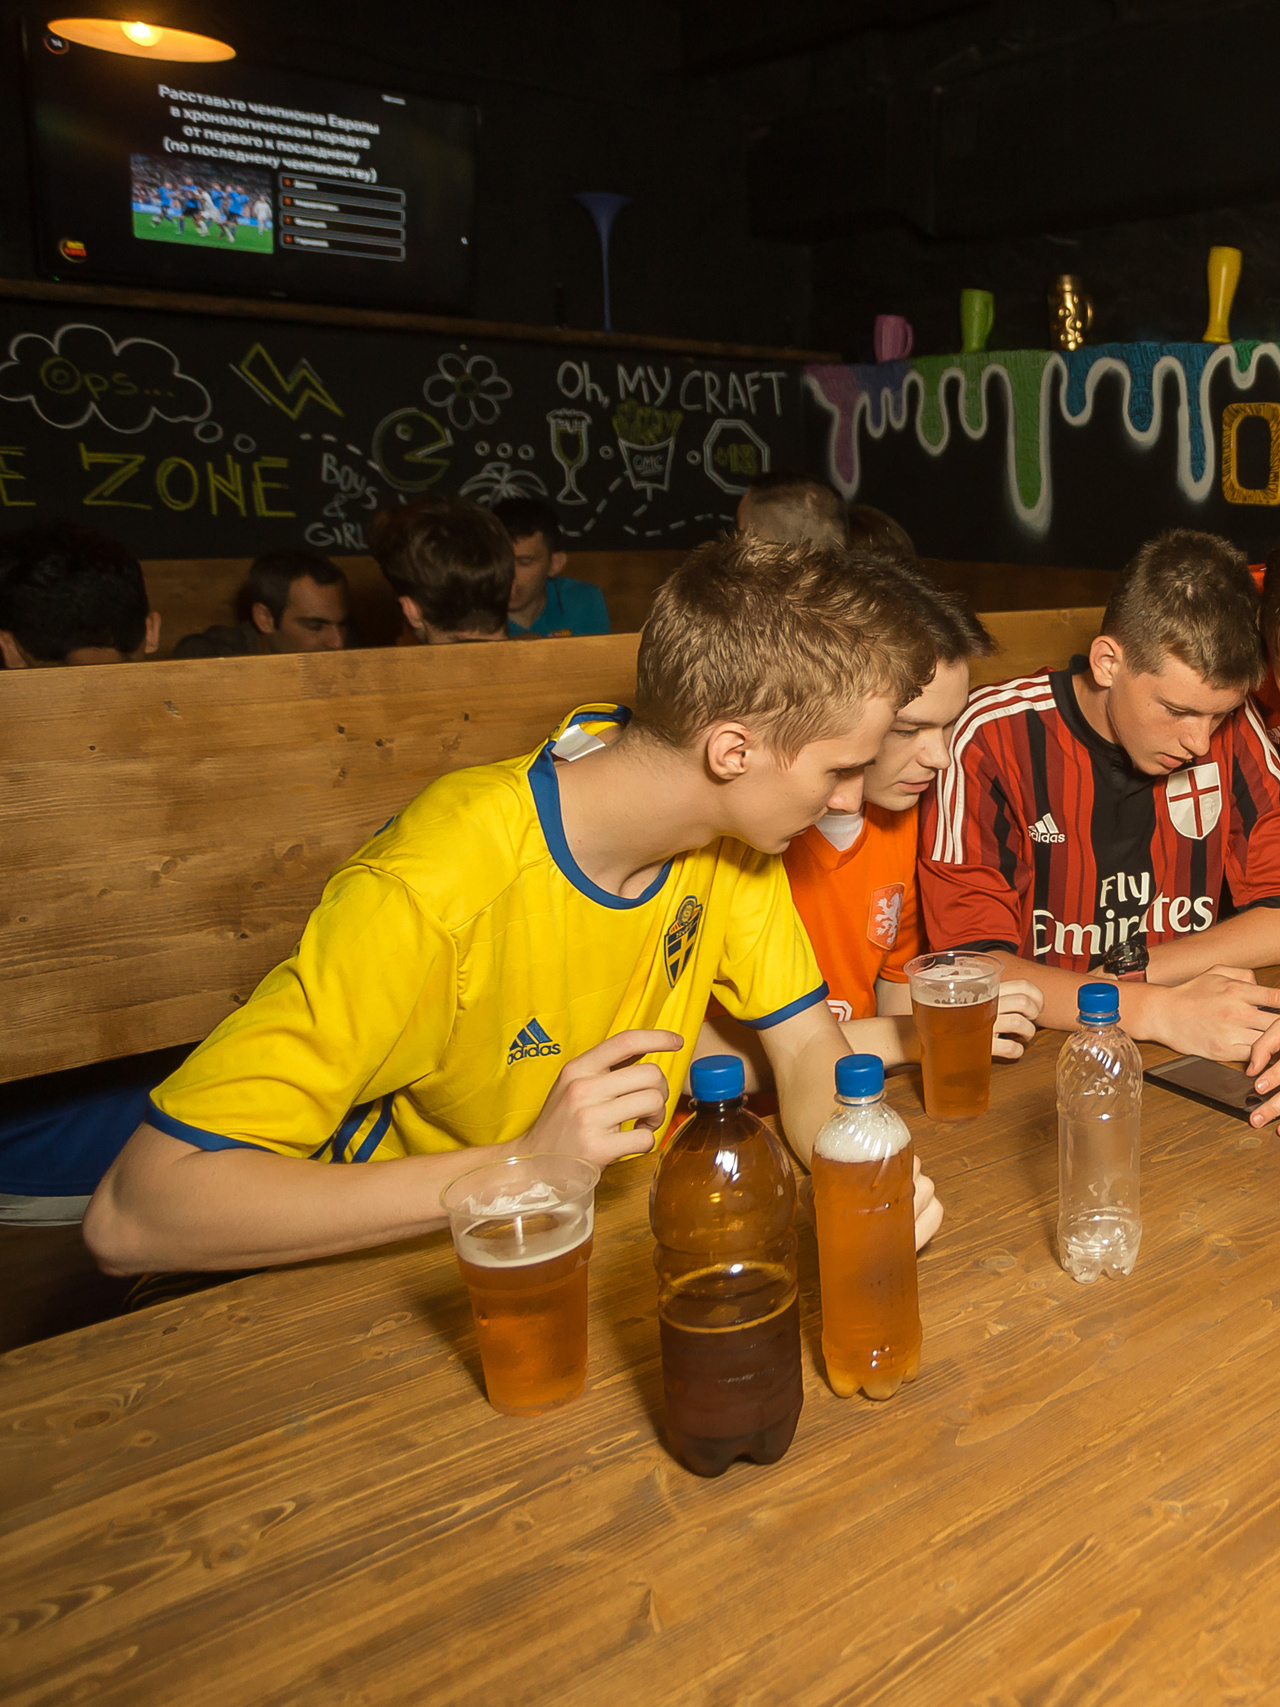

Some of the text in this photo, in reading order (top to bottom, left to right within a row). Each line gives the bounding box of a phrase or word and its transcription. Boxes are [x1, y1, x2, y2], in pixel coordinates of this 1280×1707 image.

[158, 84, 247, 112] Расставьте
[327, 113, 381, 135] Европы
[182, 125, 202, 139] от
[203, 127, 263, 149] первого
[617, 362, 672, 407] MY
[680, 369, 788, 417] CRAFT
[79, 441, 297, 518] ZONE
[1100, 871, 1150, 908] Fly
[506, 1040, 561, 1066] adidas
